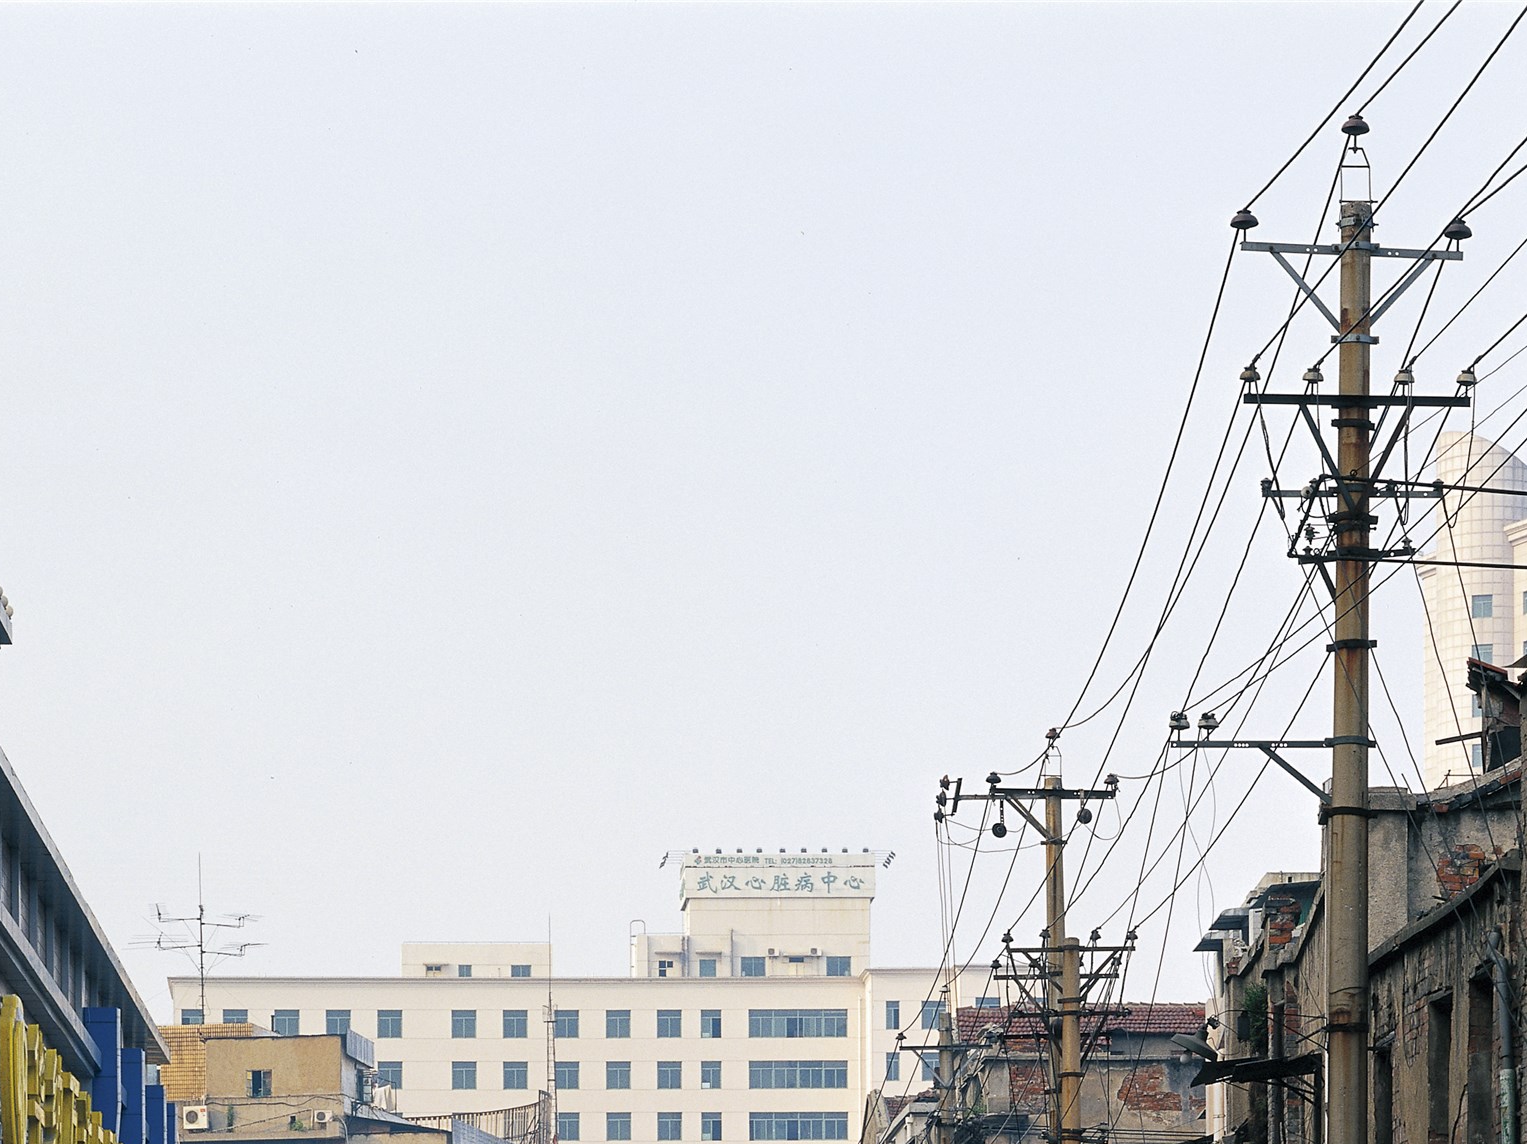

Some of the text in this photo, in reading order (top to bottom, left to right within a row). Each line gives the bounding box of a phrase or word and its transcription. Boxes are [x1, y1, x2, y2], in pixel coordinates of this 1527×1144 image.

[703, 855, 760, 865] 武汉市中心医院
[696, 871, 865, 894] 武汉心脏病中心
